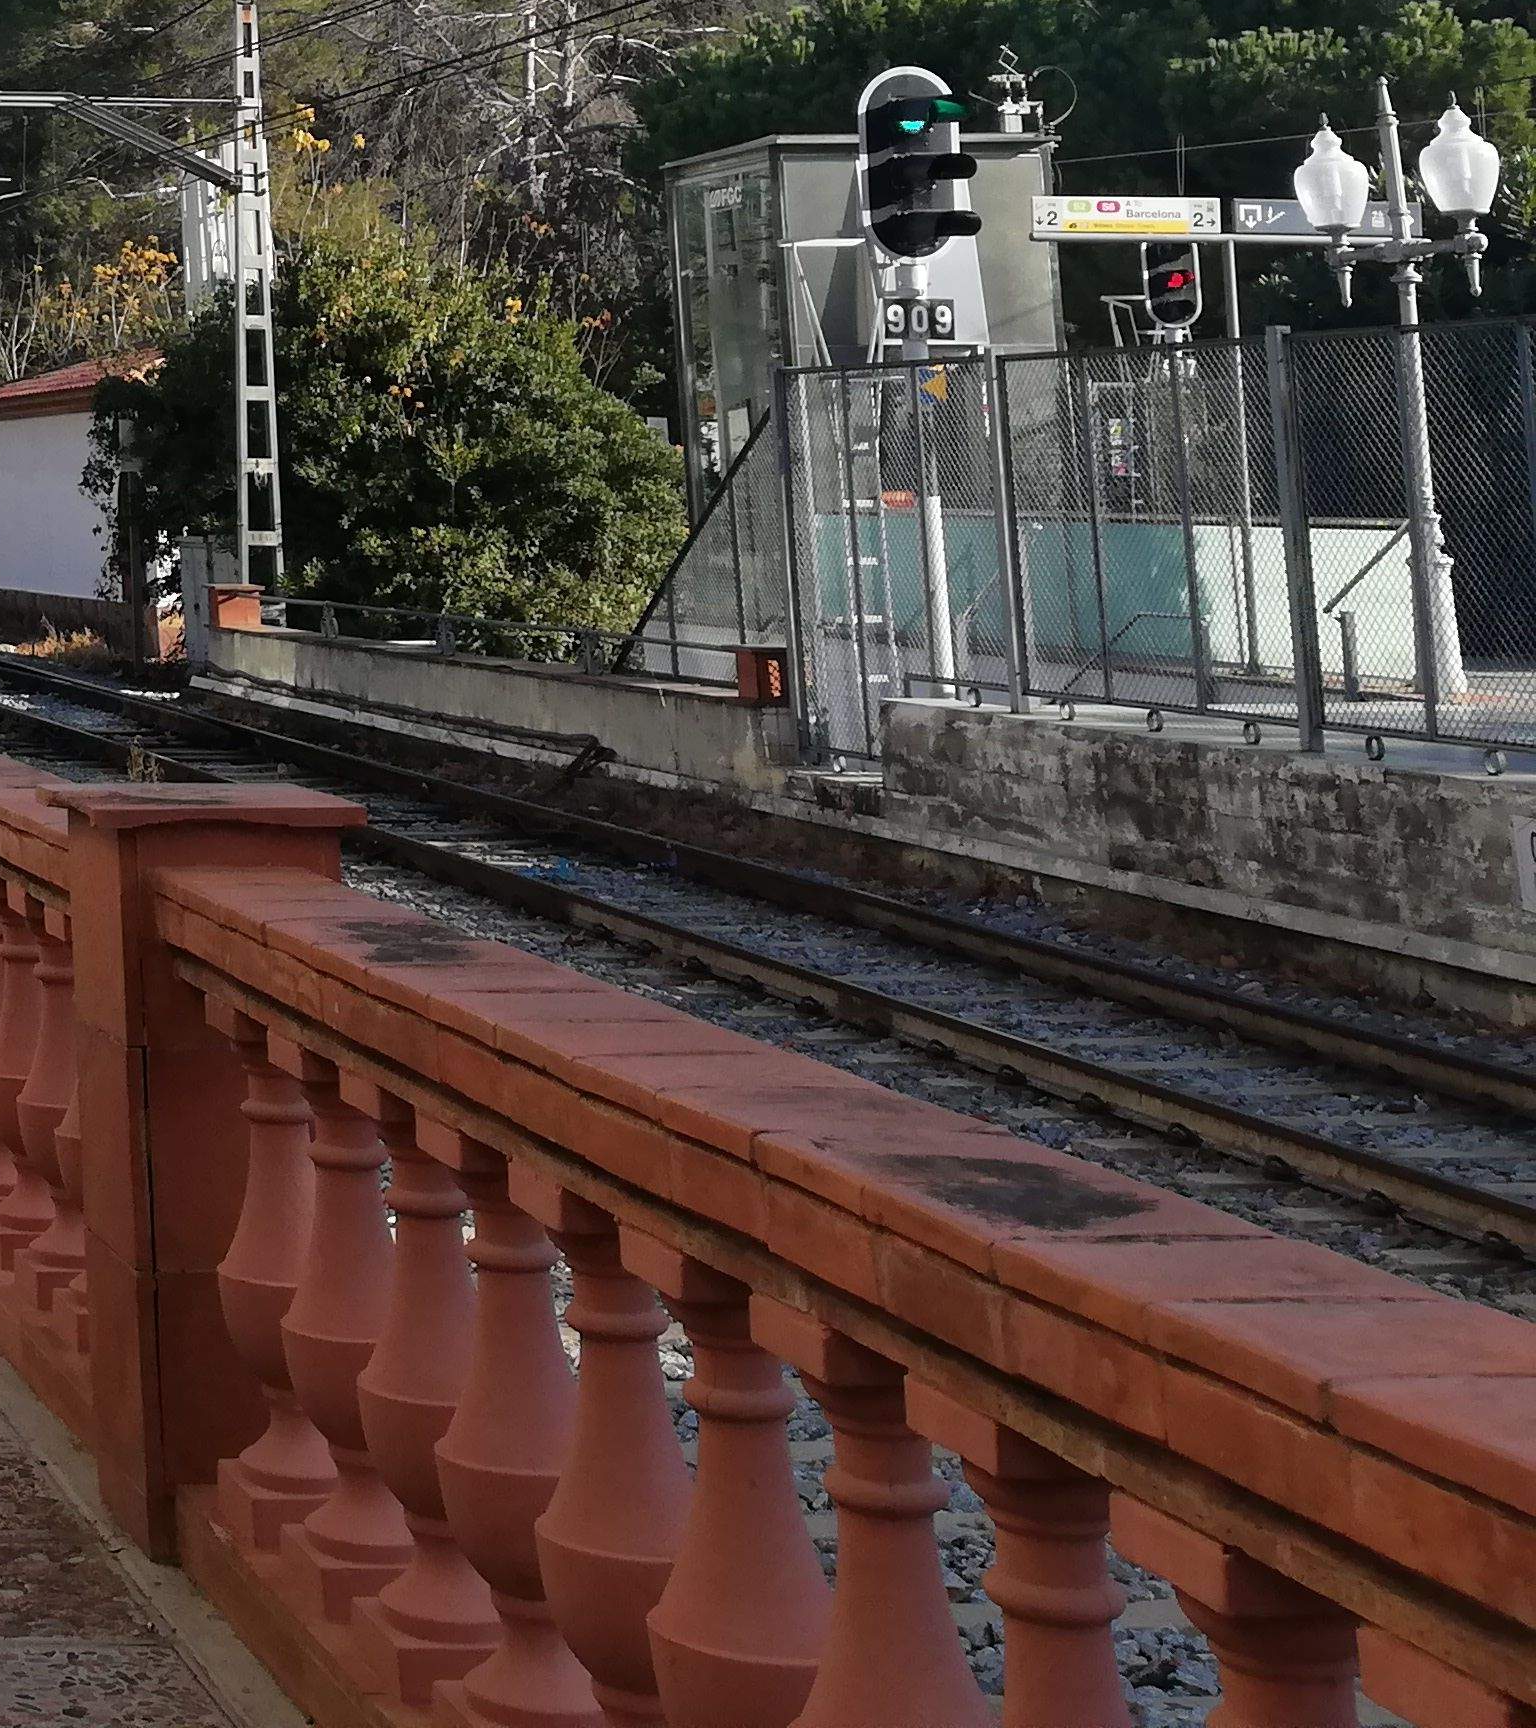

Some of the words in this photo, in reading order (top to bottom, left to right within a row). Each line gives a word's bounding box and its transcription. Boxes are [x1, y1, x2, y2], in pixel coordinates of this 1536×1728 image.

[1046, 210, 1059, 226] 2
[1126, 209, 1181, 219] Barcelona
[1193, 212, 1205, 227] 2
[886, 303, 953, 334] 909
